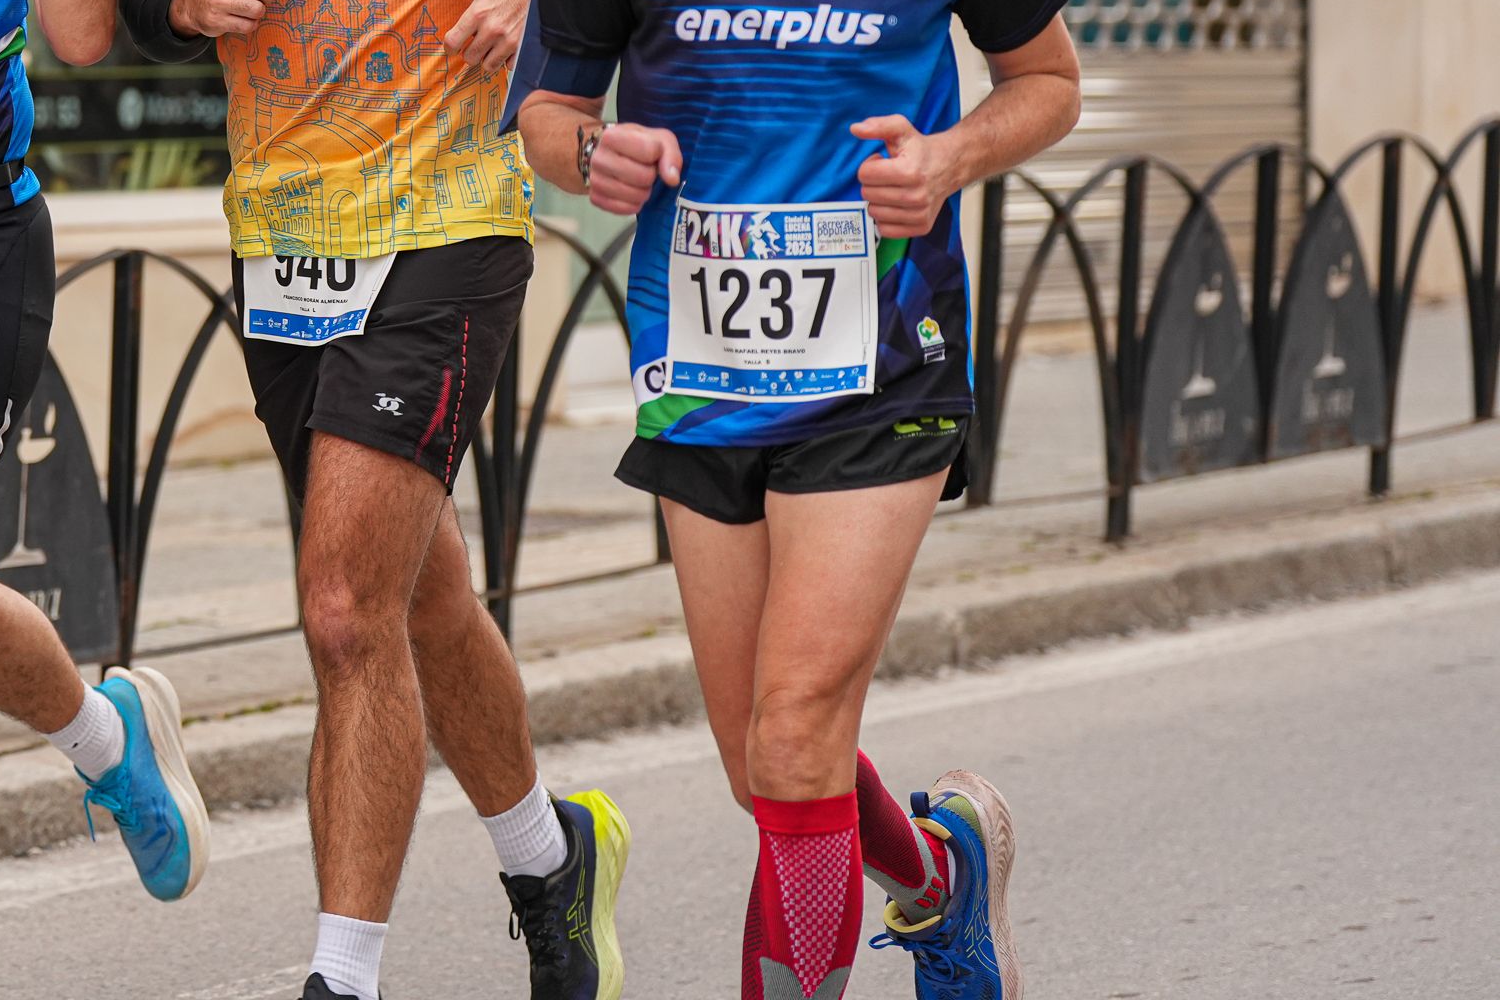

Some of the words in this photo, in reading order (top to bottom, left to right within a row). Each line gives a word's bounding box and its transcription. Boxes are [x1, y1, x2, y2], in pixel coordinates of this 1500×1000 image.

[817, 219, 855, 231] carreras
[817, 225, 862, 238] populares
[686, 210, 746, 258] 21K
[785, 240, 813, 256] 2026
[690, 266, 836, 340] 1237
